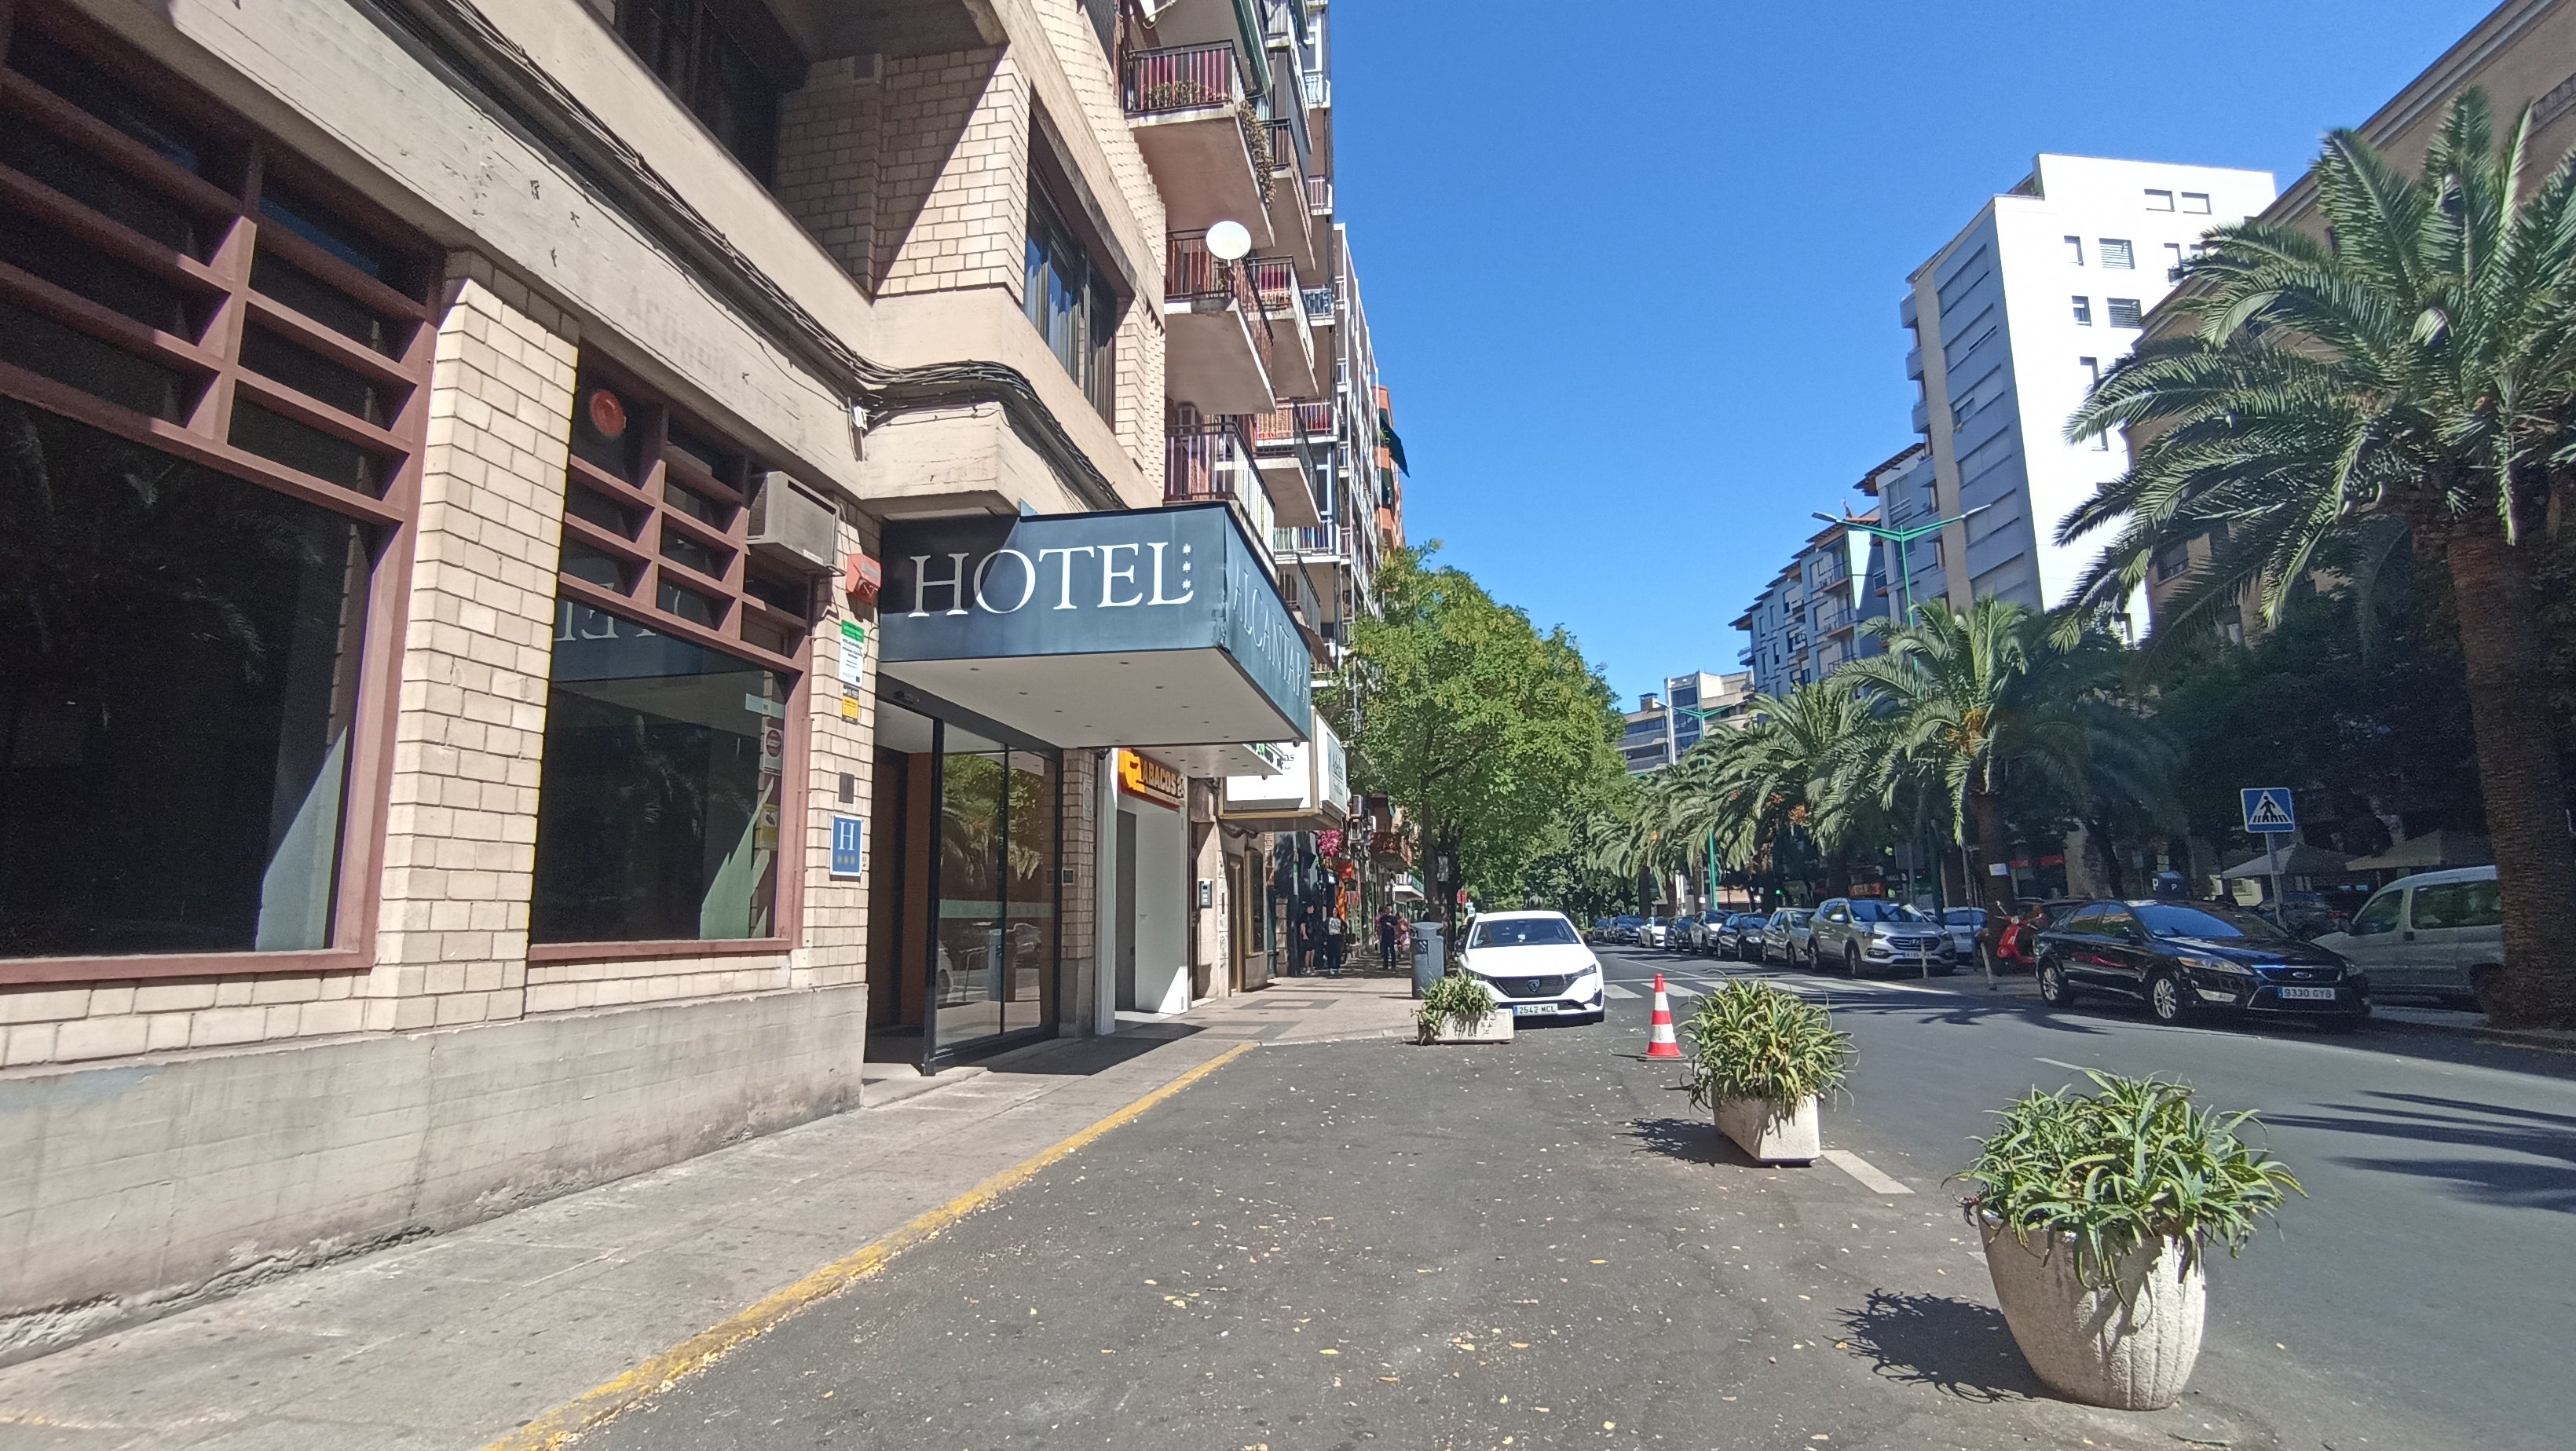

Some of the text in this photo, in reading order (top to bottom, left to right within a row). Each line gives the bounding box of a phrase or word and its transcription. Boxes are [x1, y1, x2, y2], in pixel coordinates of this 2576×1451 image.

[907, 541, 1194, 618] HOTEL
[838, 821, 855, 851] H
[2152, 878, 2159, 891] P
[2284, 988, 2333, 999] 9330 GYB
[1519, 1006, 1539, 1014] 2542
